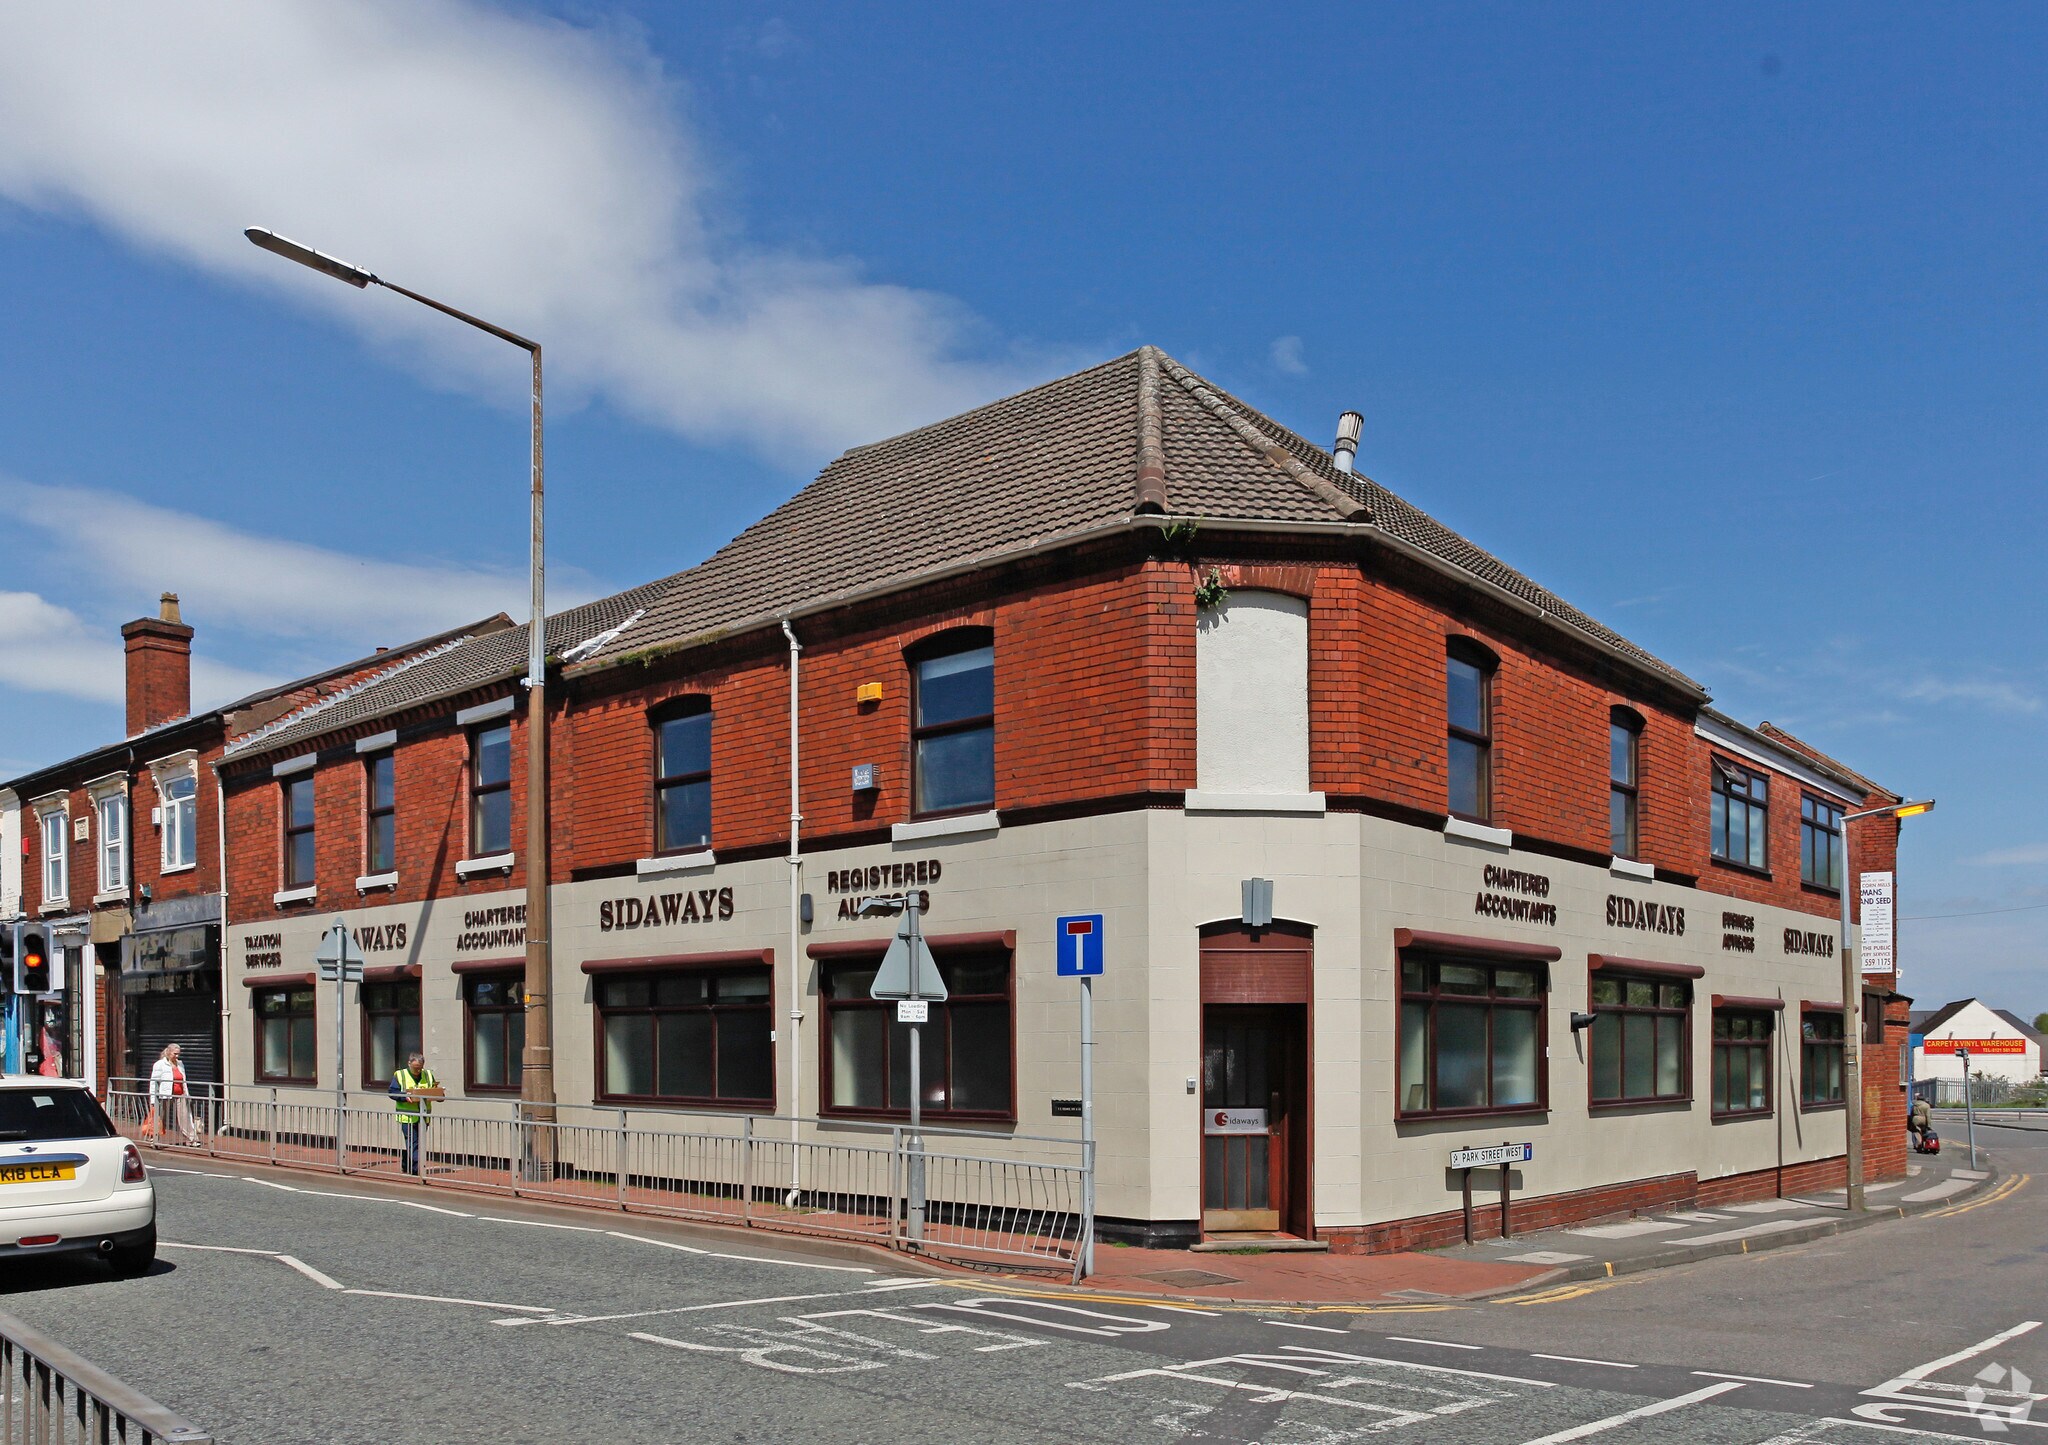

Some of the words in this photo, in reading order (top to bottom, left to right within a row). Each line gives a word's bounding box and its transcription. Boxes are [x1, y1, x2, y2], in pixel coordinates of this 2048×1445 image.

[828, 859, 941, 894] REGISTERED
[1484, 864, 1549, 898] CHARTERED
[600, 887, 734, 931] SIDAWAYS
[1475, 892, 1556, 926] ACCOUNTANTS
[1876, 897, 1891, 905] SEED
[1606, 894, 1685, 936] SIDAWAYS
[244, 933, 281, 951] TAXATION
[1784, 928, 1833, 958] SIDAWAYS
[246, 952, 281, 969] SERVICES
[1865, 959, 1875, 967] 559
[1462, 1152, 1479, 1163] PARK
[1481, 1148, 1503, 1160] STREET
[1505, 1146, 1521, 1157] WEST
[30, 1166, 61, 1179] CLA
